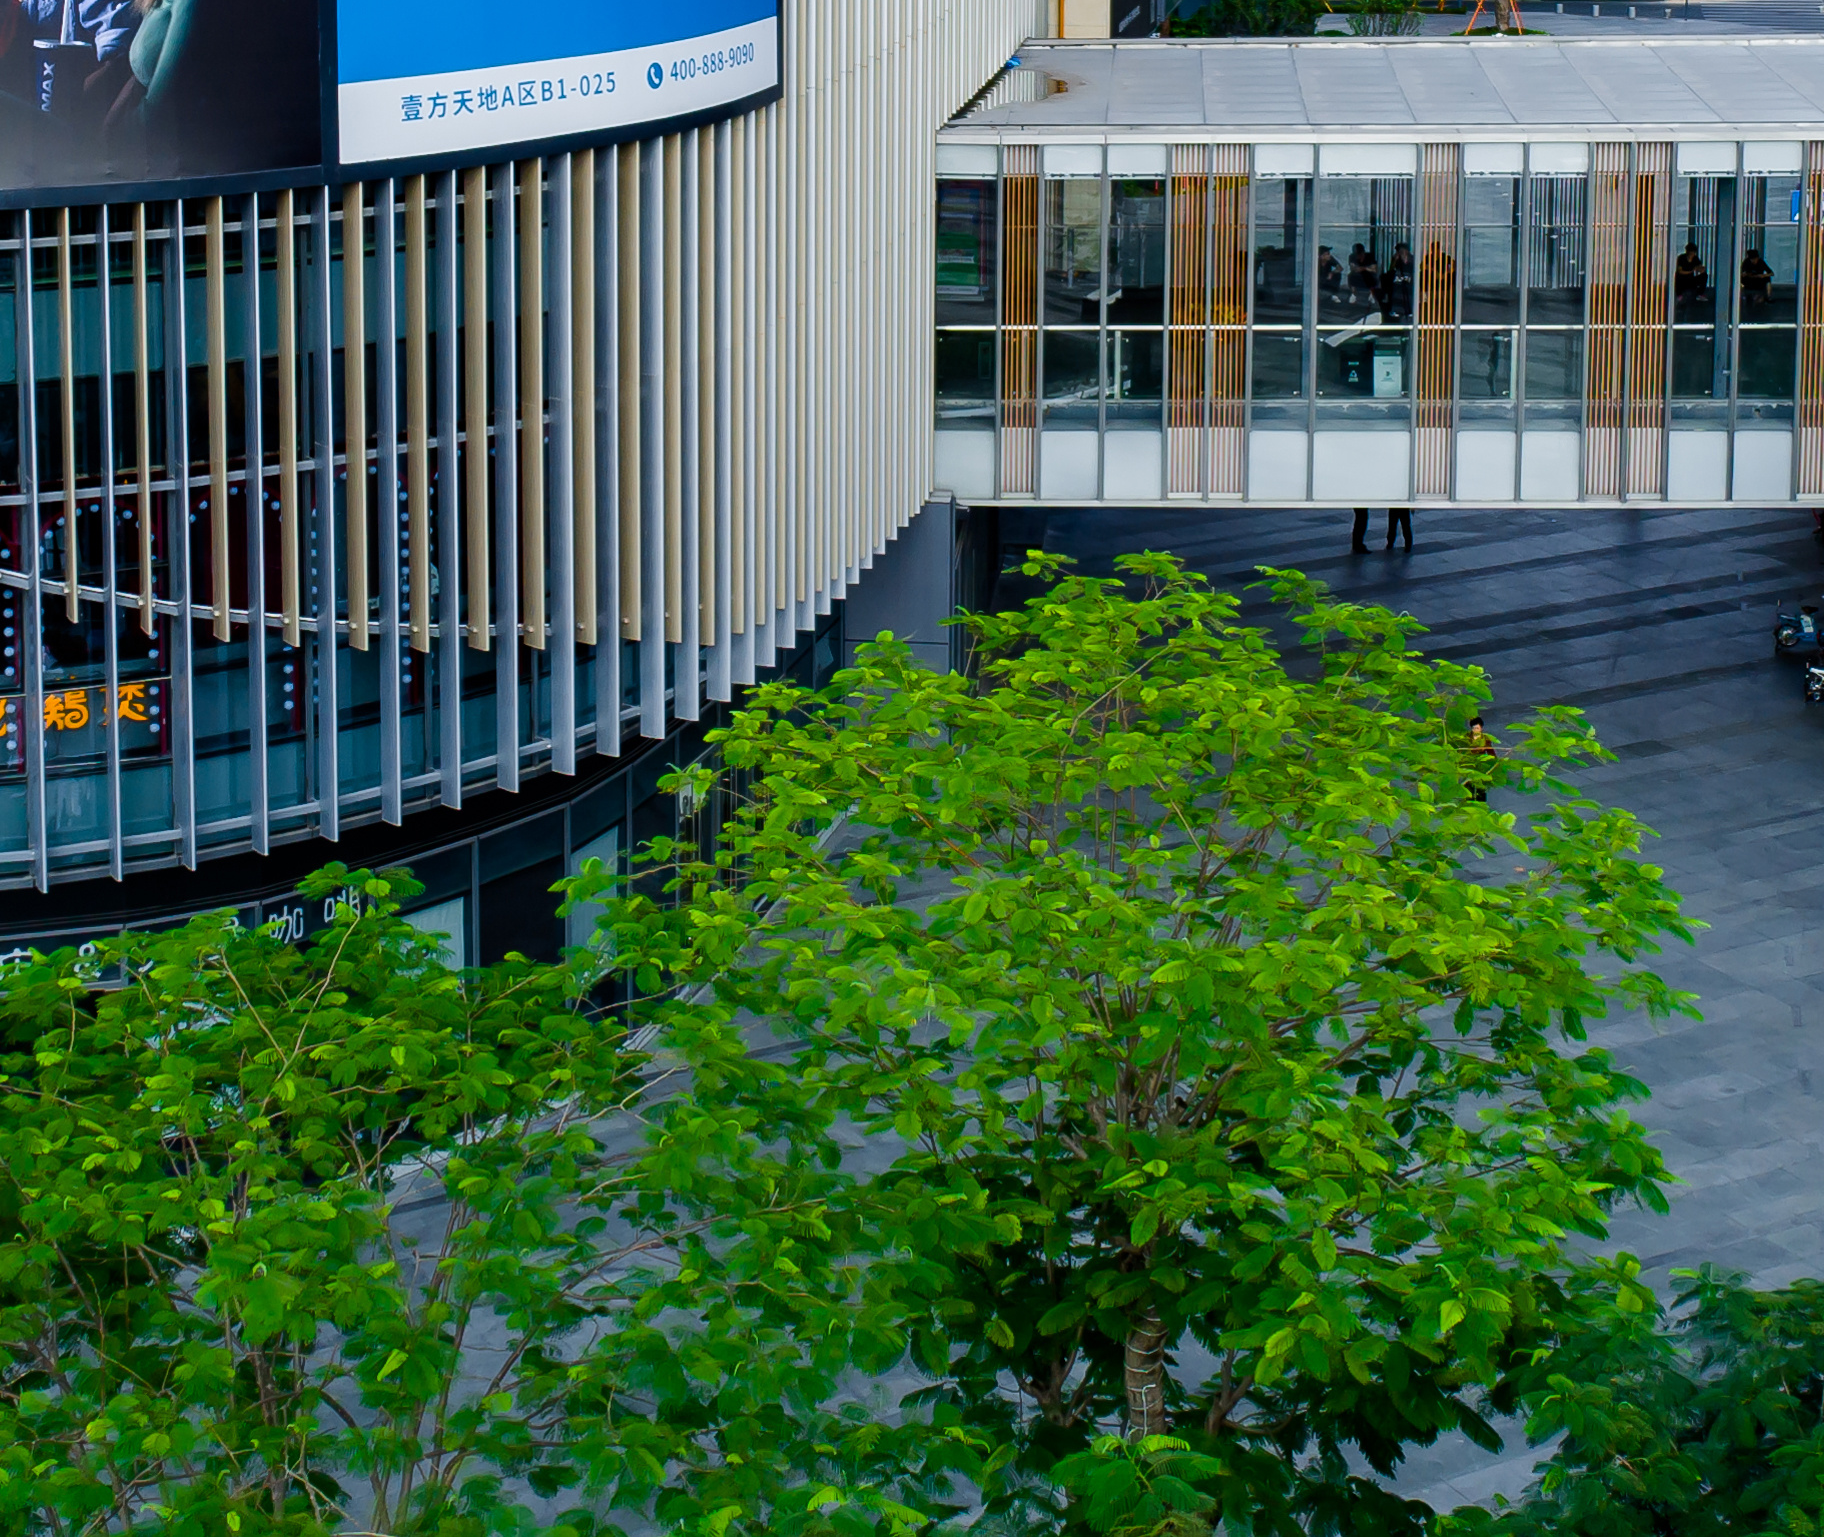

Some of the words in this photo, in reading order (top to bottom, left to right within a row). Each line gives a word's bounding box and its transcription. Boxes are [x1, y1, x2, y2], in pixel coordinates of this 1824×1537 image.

[400, 71, 617, 122] 壹方天地A区B1-025
[669, 41, 756, 82] 400-888-9090
